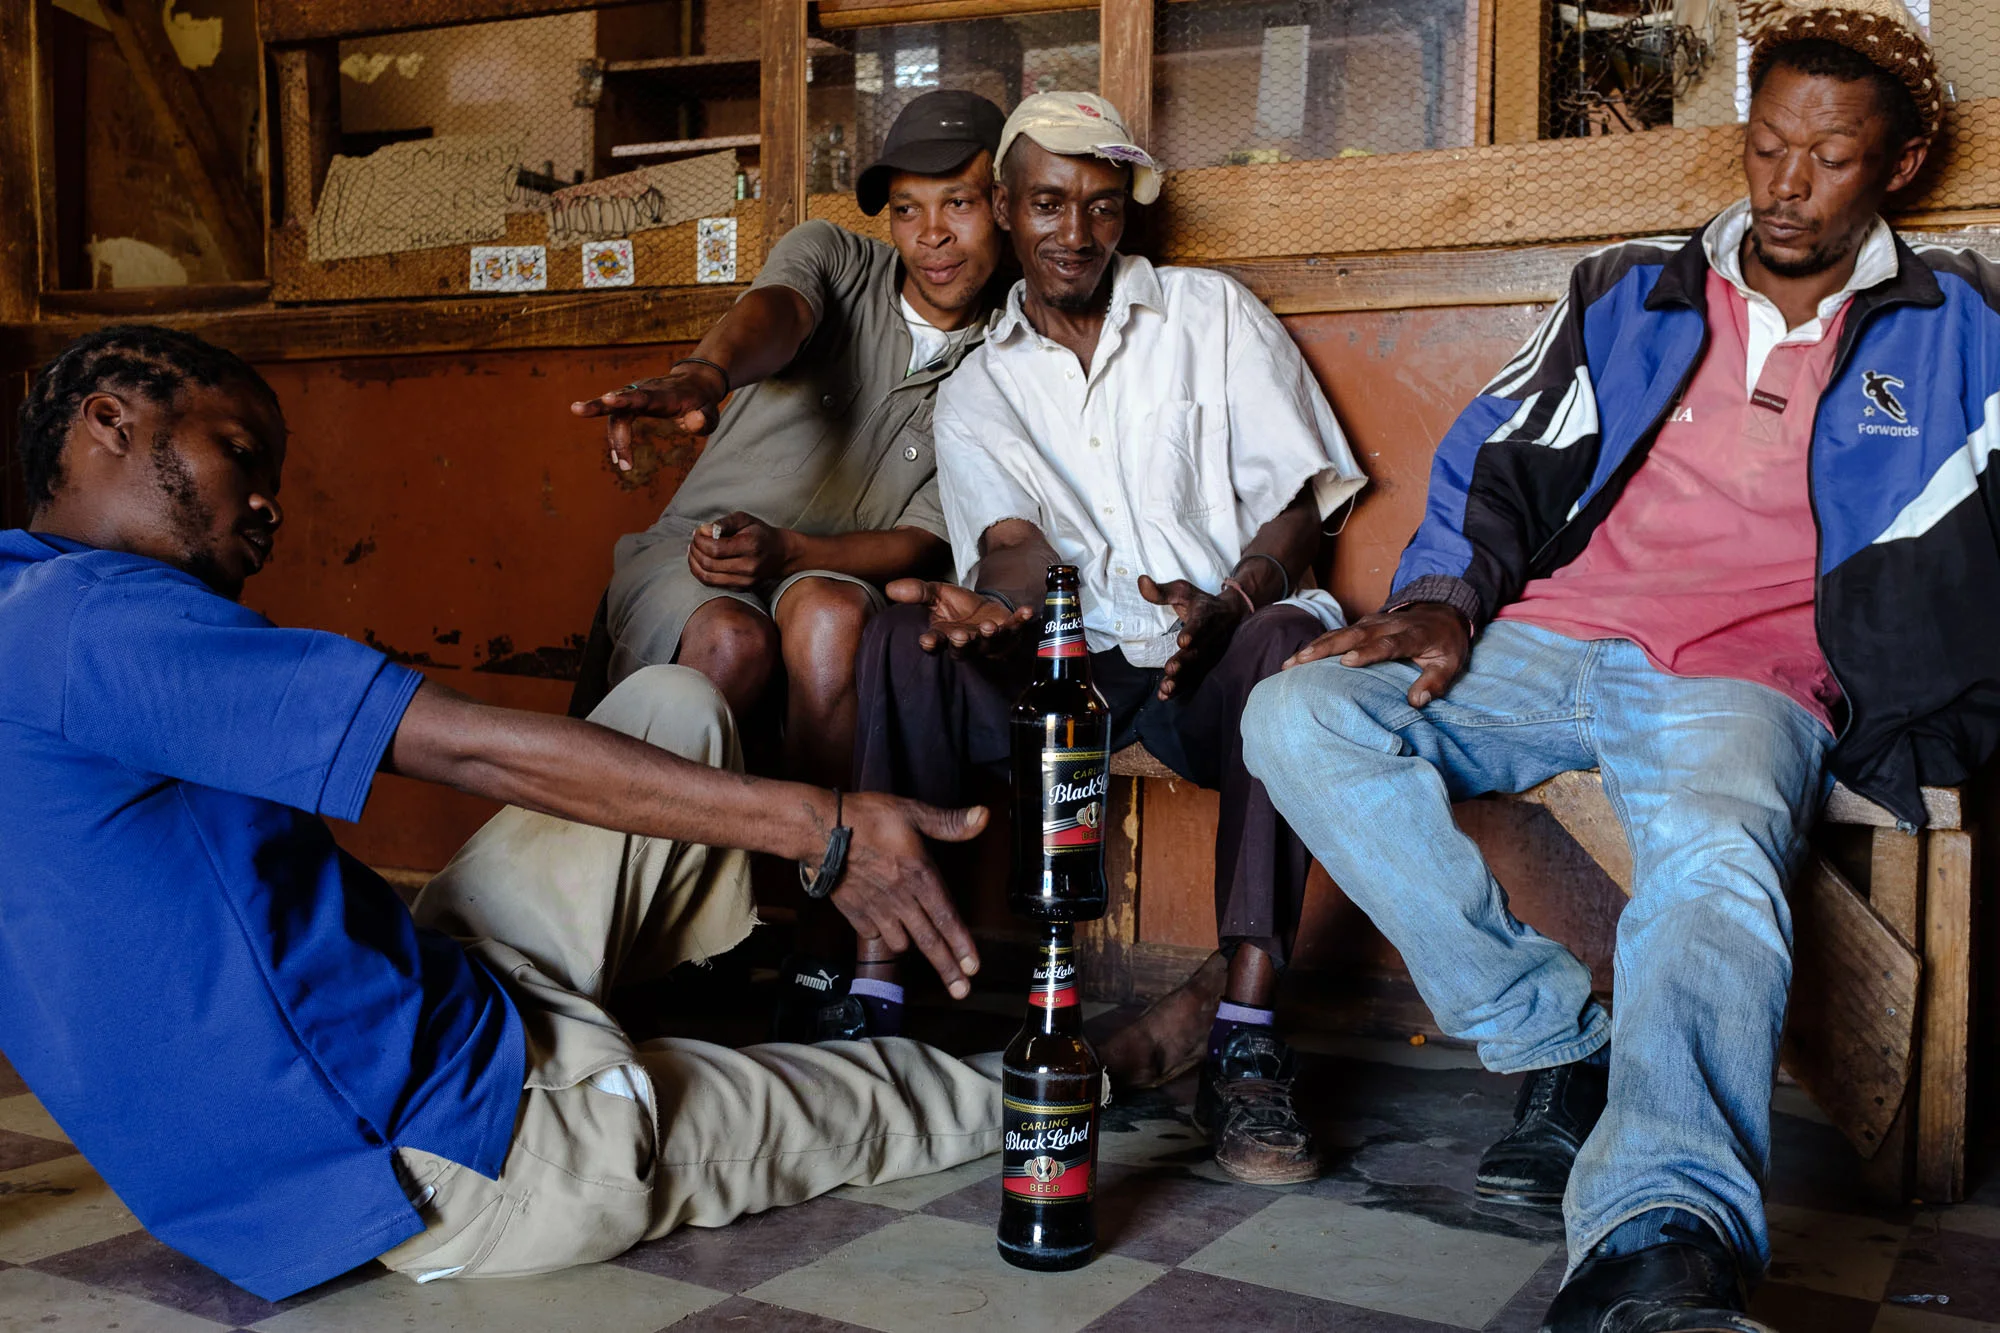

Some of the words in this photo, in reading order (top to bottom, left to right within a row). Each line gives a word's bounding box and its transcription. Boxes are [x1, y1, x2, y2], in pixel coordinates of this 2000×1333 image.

[1858, 422, 1919, 437] Forwards
[1060, 612, 1080, 620] CARL
[1044, 618, 1079, 634] Black
[1073, 766, 1101, 780] CARL
[1048, 778, 1097, 805] Black
[1052, 964, 1075, 979] Lab
[795, 973, 828, 991] PUMA
[1021, 1118, 1069, 1131] CARLING
[1005, 1130, 1046, 1151] Black
[1046, 1121, 1090, 1151] Label
[1029, 1184, 1060, 1192] BEER
